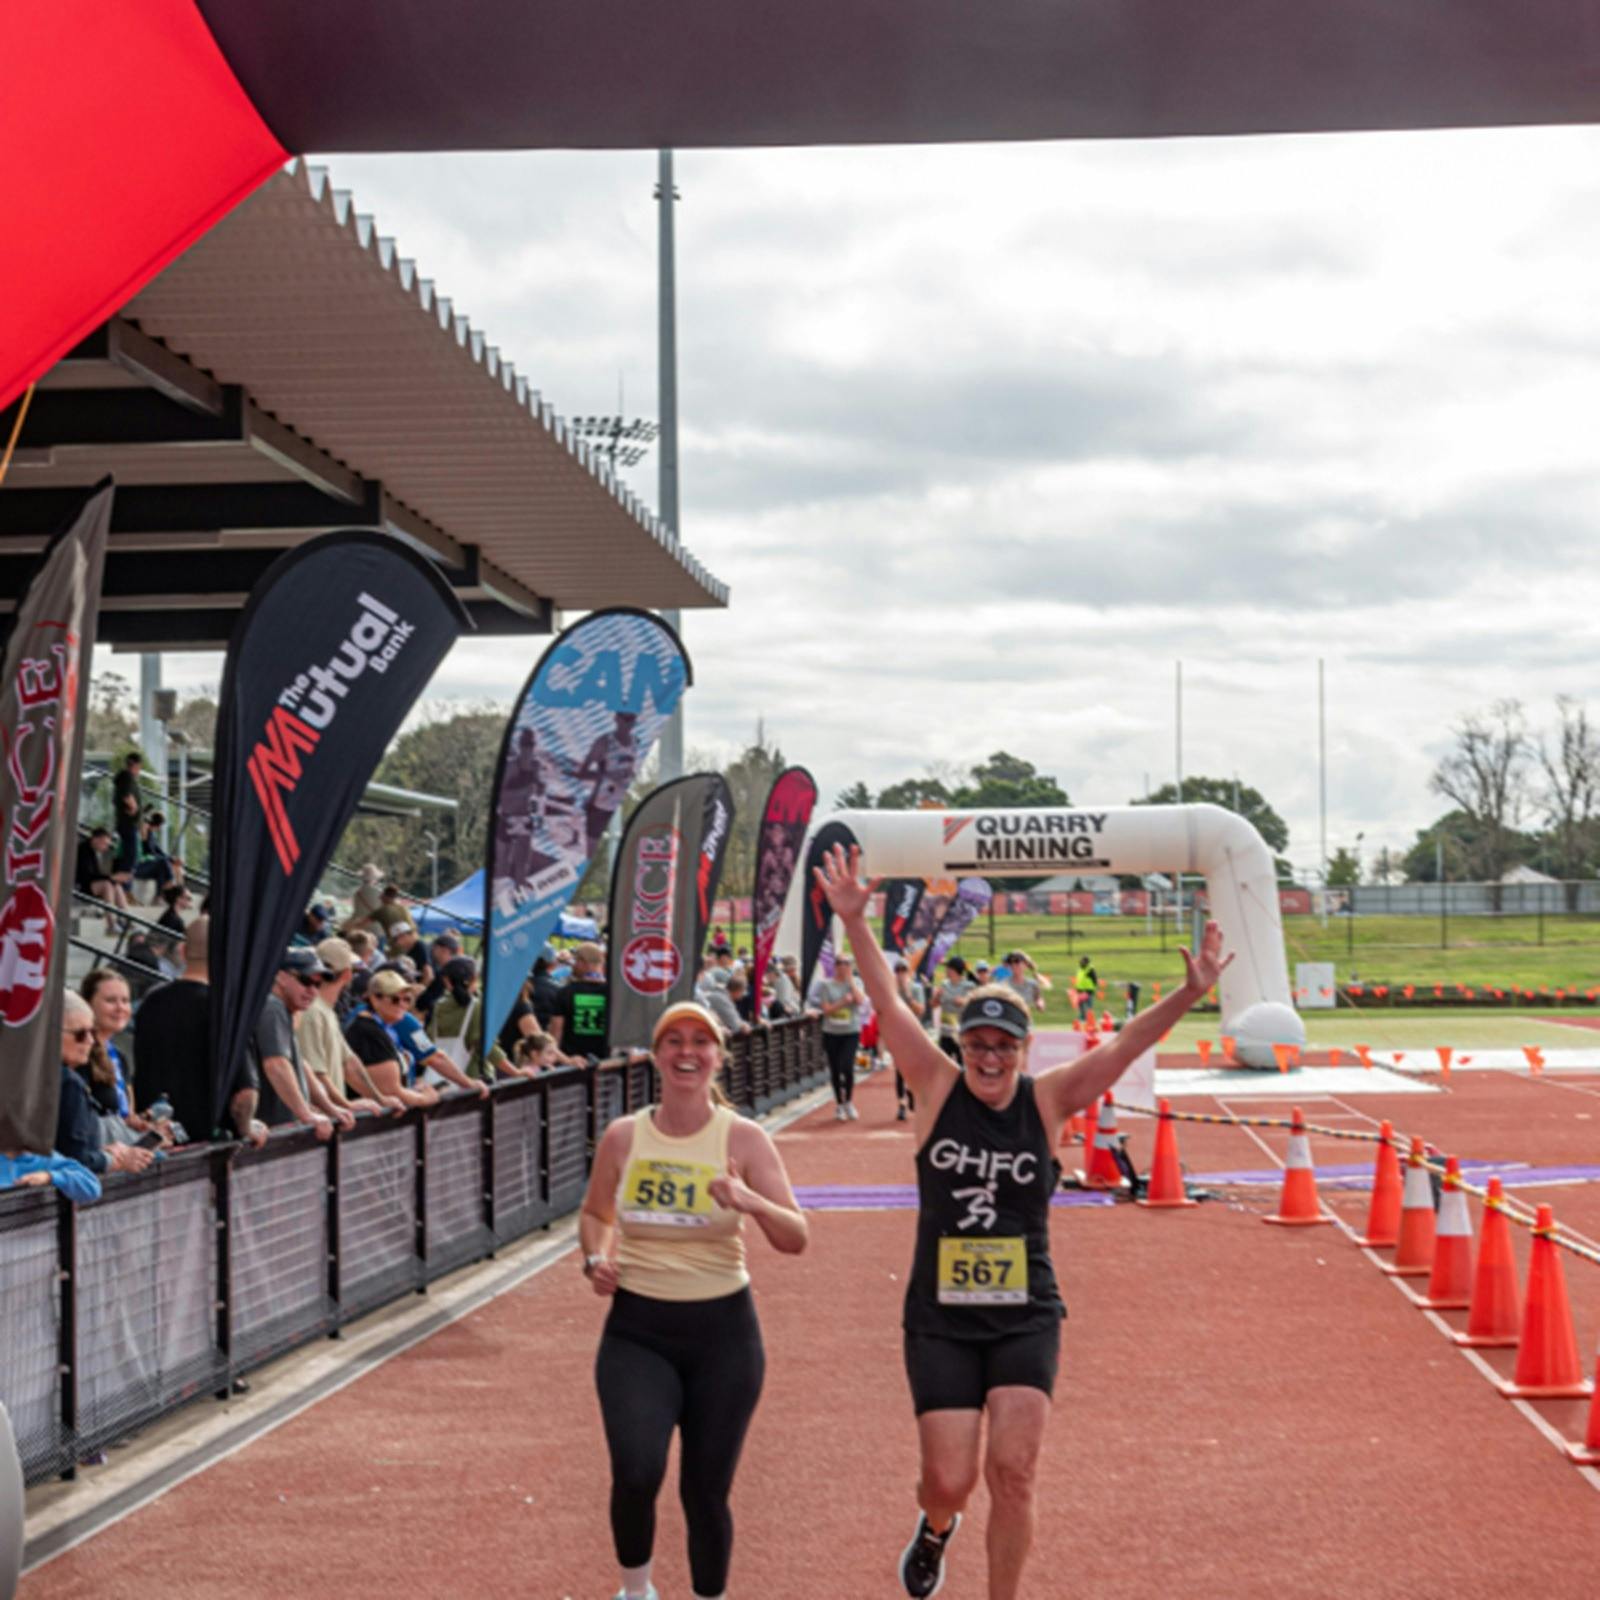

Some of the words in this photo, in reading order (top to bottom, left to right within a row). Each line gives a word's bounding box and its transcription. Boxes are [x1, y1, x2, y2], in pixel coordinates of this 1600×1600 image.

[368, 619, 416, 674] Bank
[278, 673, 311, 710] The
[246, 591, 400, 877] Mutual
[5, 643, 66, 885] KCE
[975, 813, 1107, 836] QUARRY
[975, 836, 1094, 861] MINING
[633, 834, 678, 934] KCE
[929, 1138, 1037, 1185] GHFC
[635, 1179, 696, 1208] 581
[951, 1260, 1013, 1285] 567
